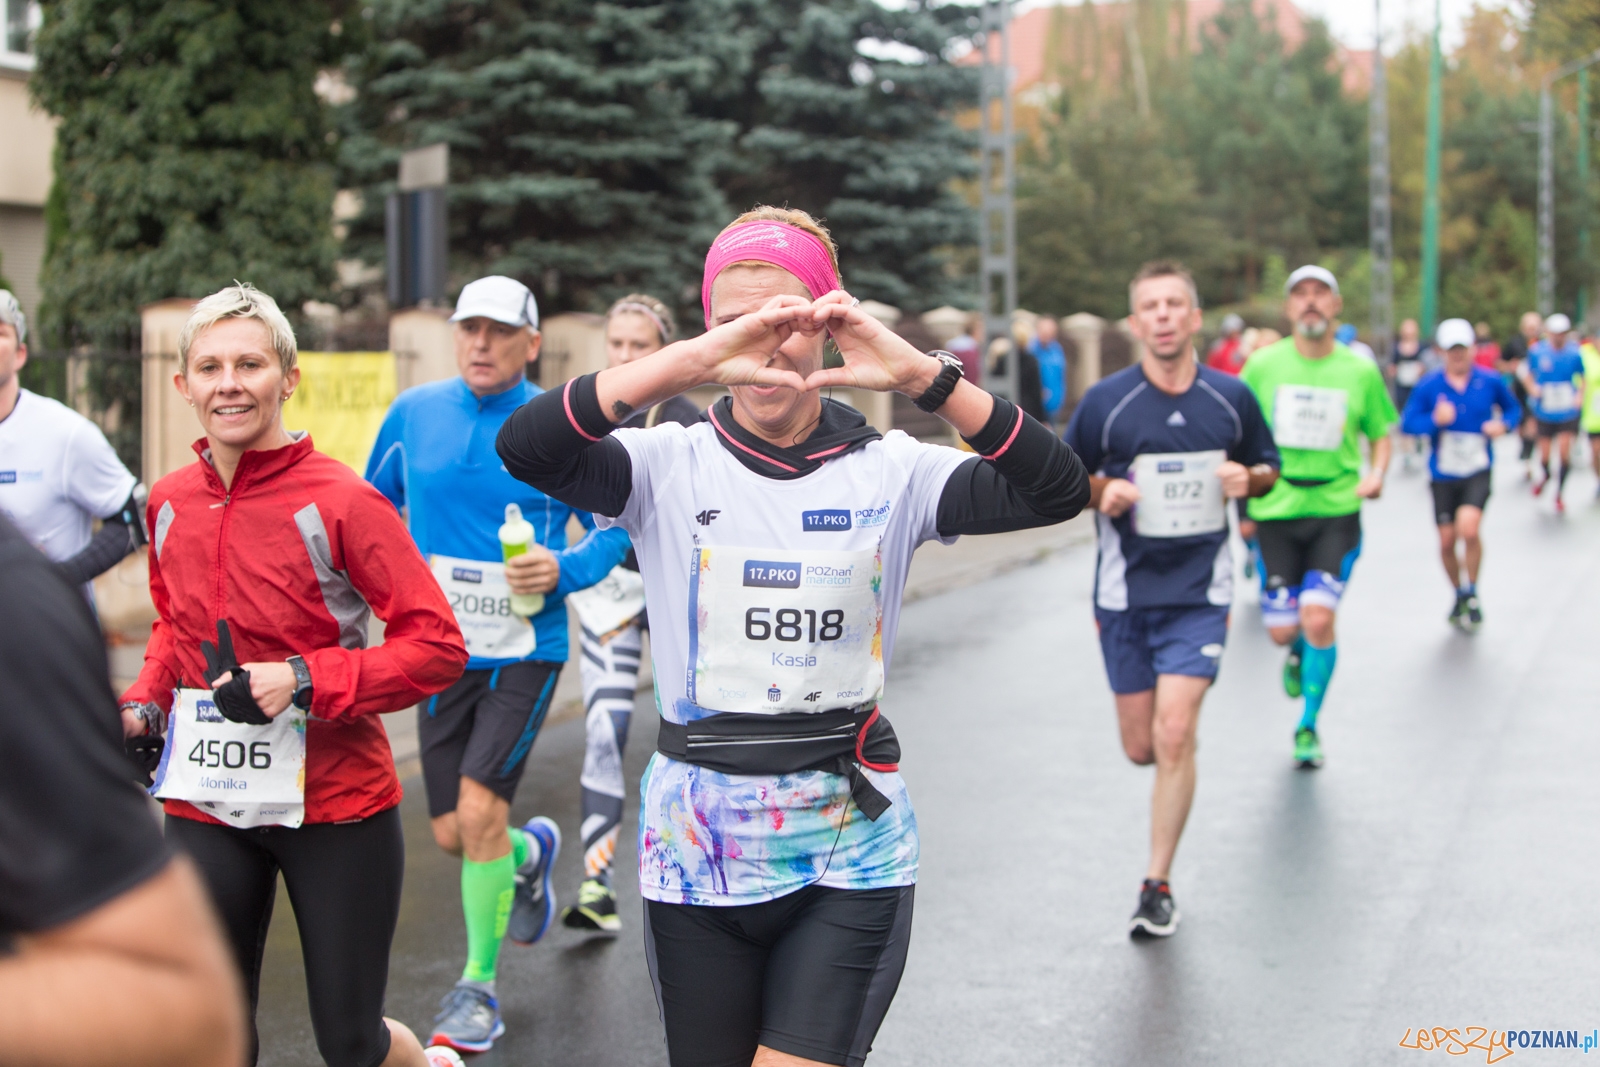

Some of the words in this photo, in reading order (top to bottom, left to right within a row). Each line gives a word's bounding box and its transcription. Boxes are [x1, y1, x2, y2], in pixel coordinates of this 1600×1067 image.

[1164, 481, 1203, 499] 872
[696, 510, 721, 525] 4F
[806, 577, 851, 585] maraton
[449, 591, 511, 617] 2088
[745, 607, 844, 642] 6818
[772, 652, 817, 667] Kasia
[804, 691, 822, 702] 4F
[189, 739, 271, 769] 4506
[200, 776, 247, 789] Monika
